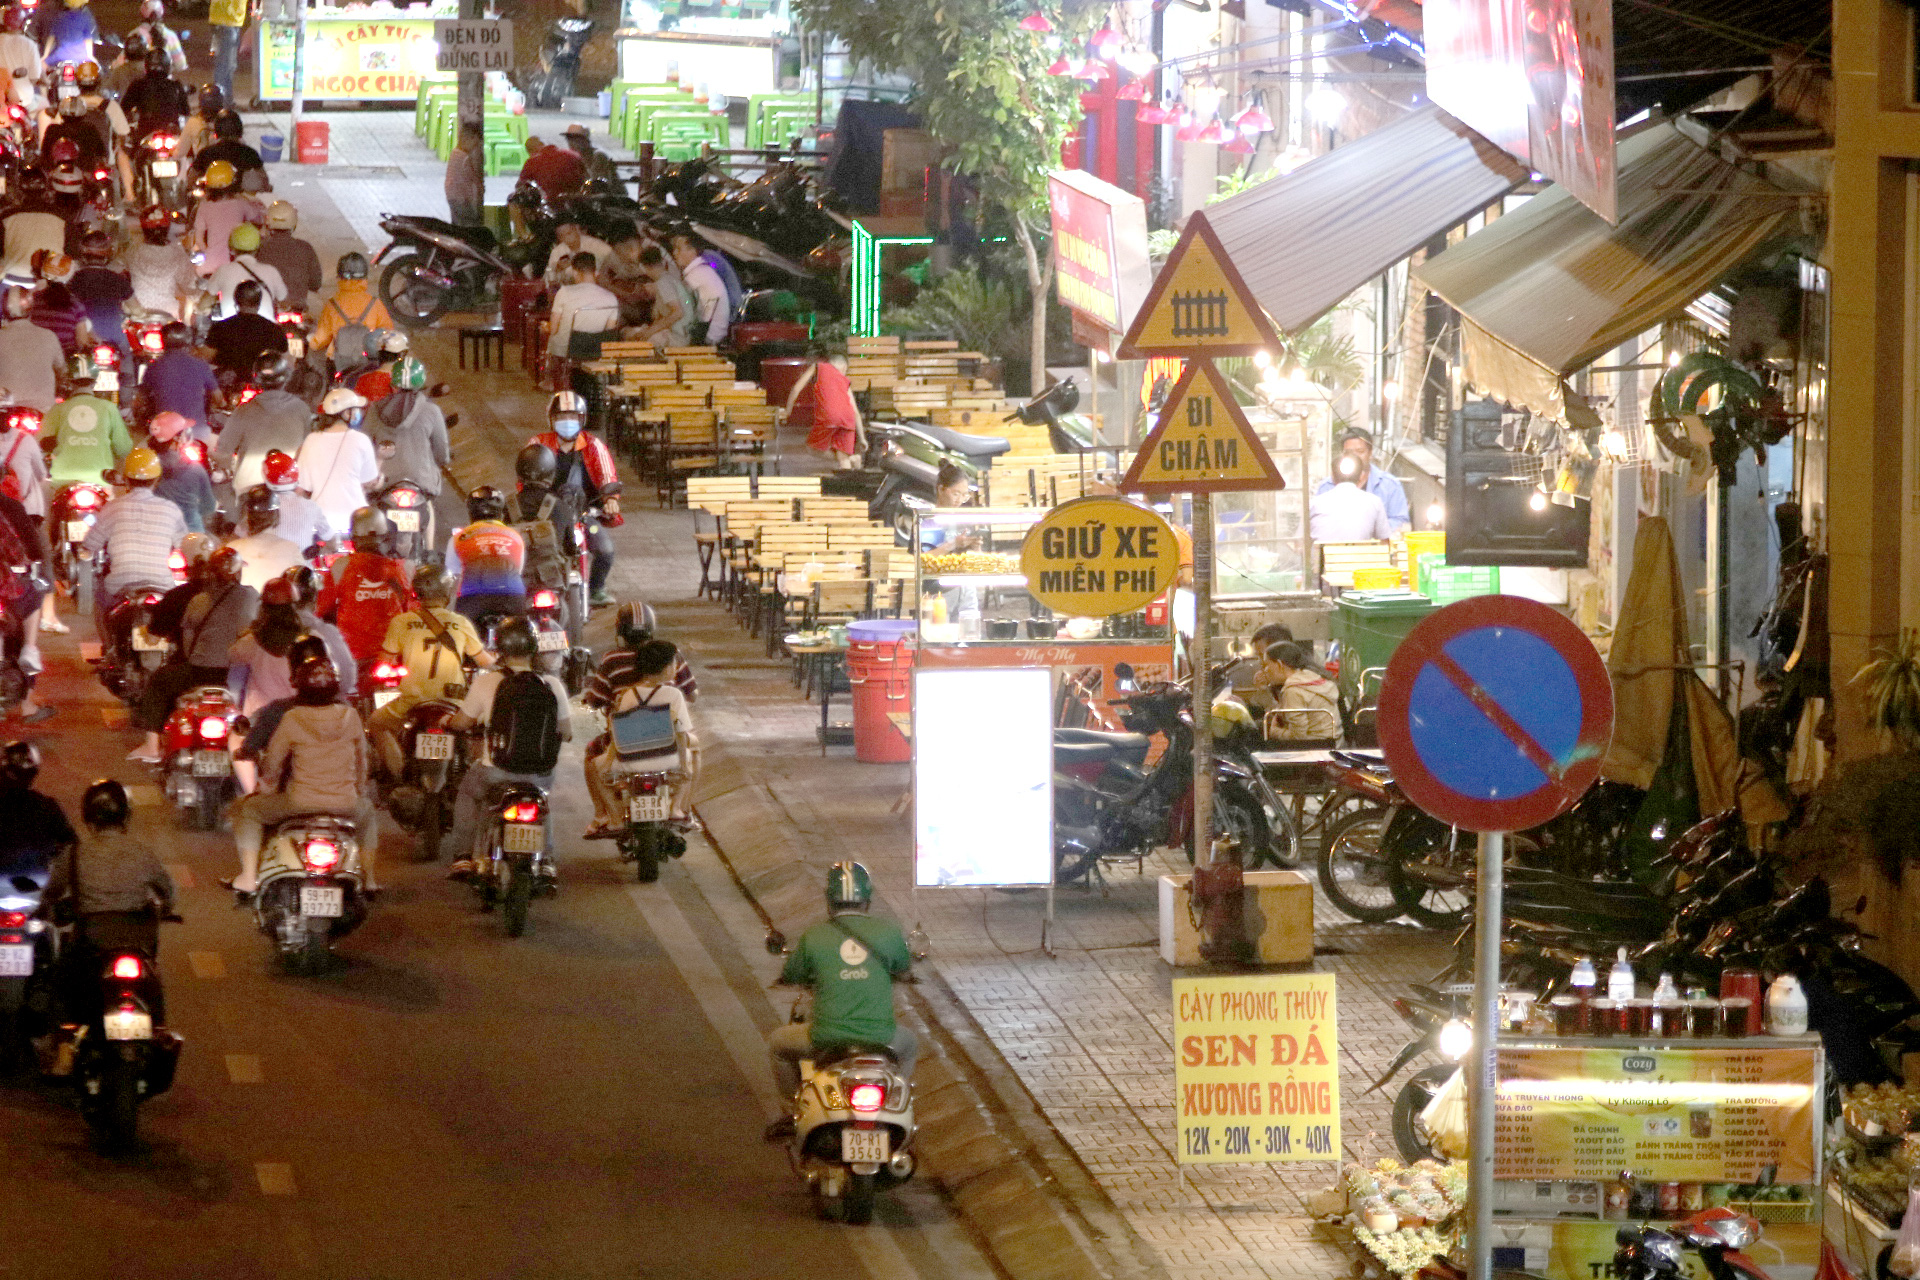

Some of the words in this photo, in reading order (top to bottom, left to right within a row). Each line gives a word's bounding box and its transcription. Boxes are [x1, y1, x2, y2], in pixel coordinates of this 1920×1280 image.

[1187, 396, 1213, 428] ĐI
[1041, 519, 1106, 560] GIỮ
[1113, 526, 1159, 559] XE
[1039, 562, 1106, 593] MIỄN
[1113, 565, 1156, 593] PHÍ
[422, 636, 442, 680] 7
[422, 746, 448, 758] 1106
[635, 809, 663, 819] 9199
[840, 968, 869, 980] Grab
[1179, 986, 1215, 1023] CÂY
[1220, 990, 1278, 1023] PHONG
[1283, 982, 1328, 1021] THỦY
[1181, 1034, 1259, 1067] SEN
[1270, 1024, 1330, 1066] ĐÁ
[1624, 1057, 1653, 1071] Cozy
[1182, 1082, 1262, 1117] XƯƠNG
[1267, 1068, 1331, 1116] RỒNG
[1608, 1097, 1619, 1107] Ly
[849, 1132, 881, 1146] 70-R1
[850, 1146, 882, 1160] 3549
[1184, 1126, 1211, 1155] 12K
[1224, 1125, 1251, 1155] 20K
[1264, 1125, 1292, 1154] 30K
[1305, 1125, 1332, 1154] 40K
